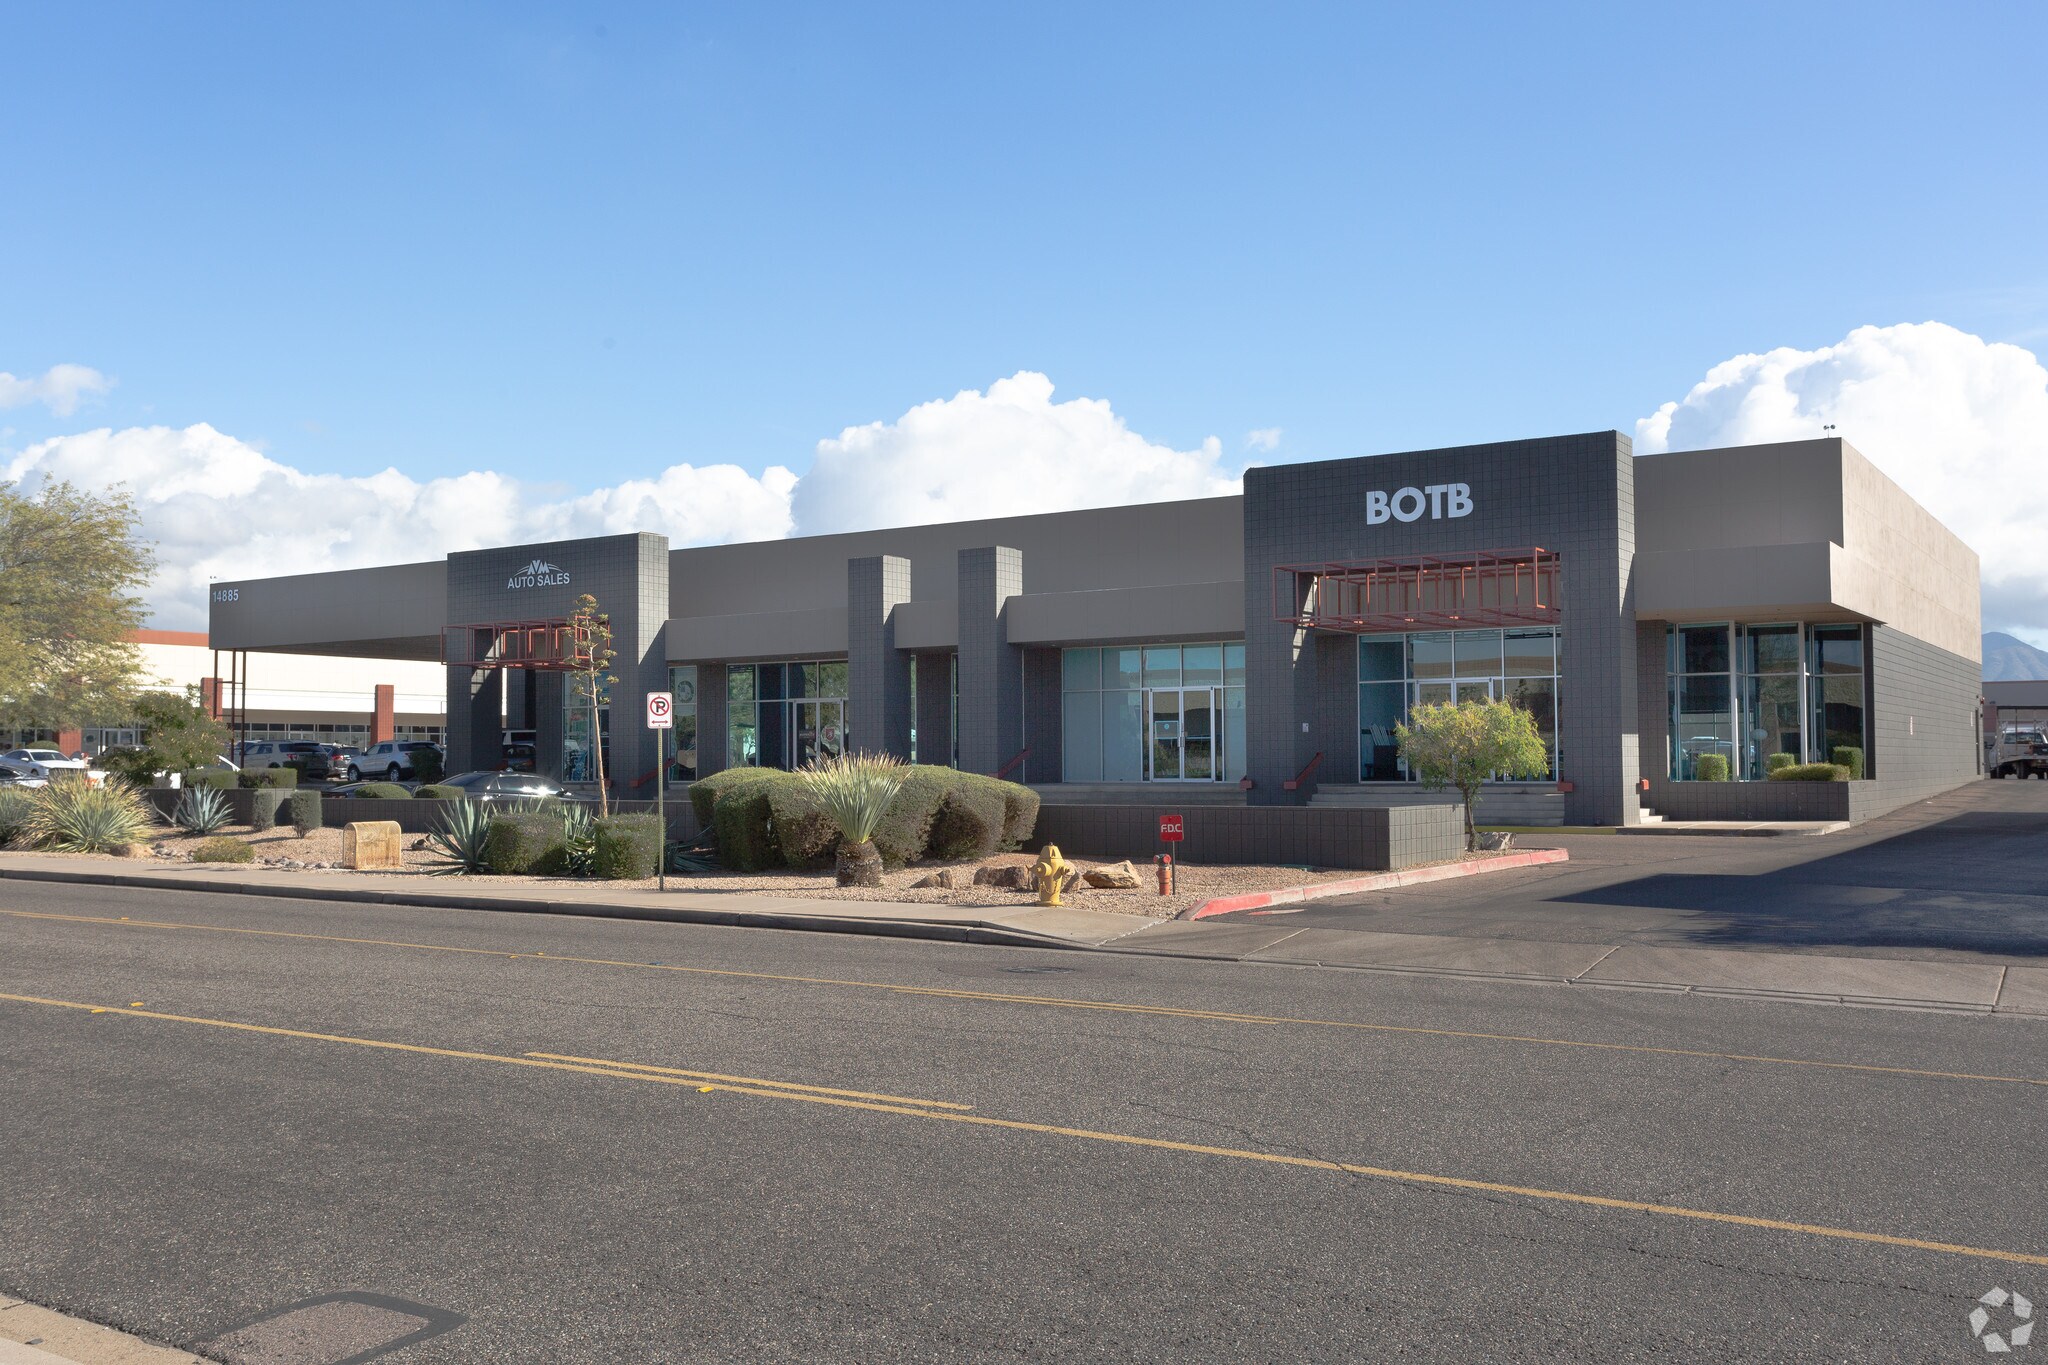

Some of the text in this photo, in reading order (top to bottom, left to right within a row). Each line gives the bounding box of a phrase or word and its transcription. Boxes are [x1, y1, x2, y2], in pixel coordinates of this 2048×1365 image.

[1366, 483, 1474, 525] BOTB
[527, 560, 550, 575] AVM
[507, 572, 570, 589] AUTO SALES
[212, 589, 239, 602] 14885
